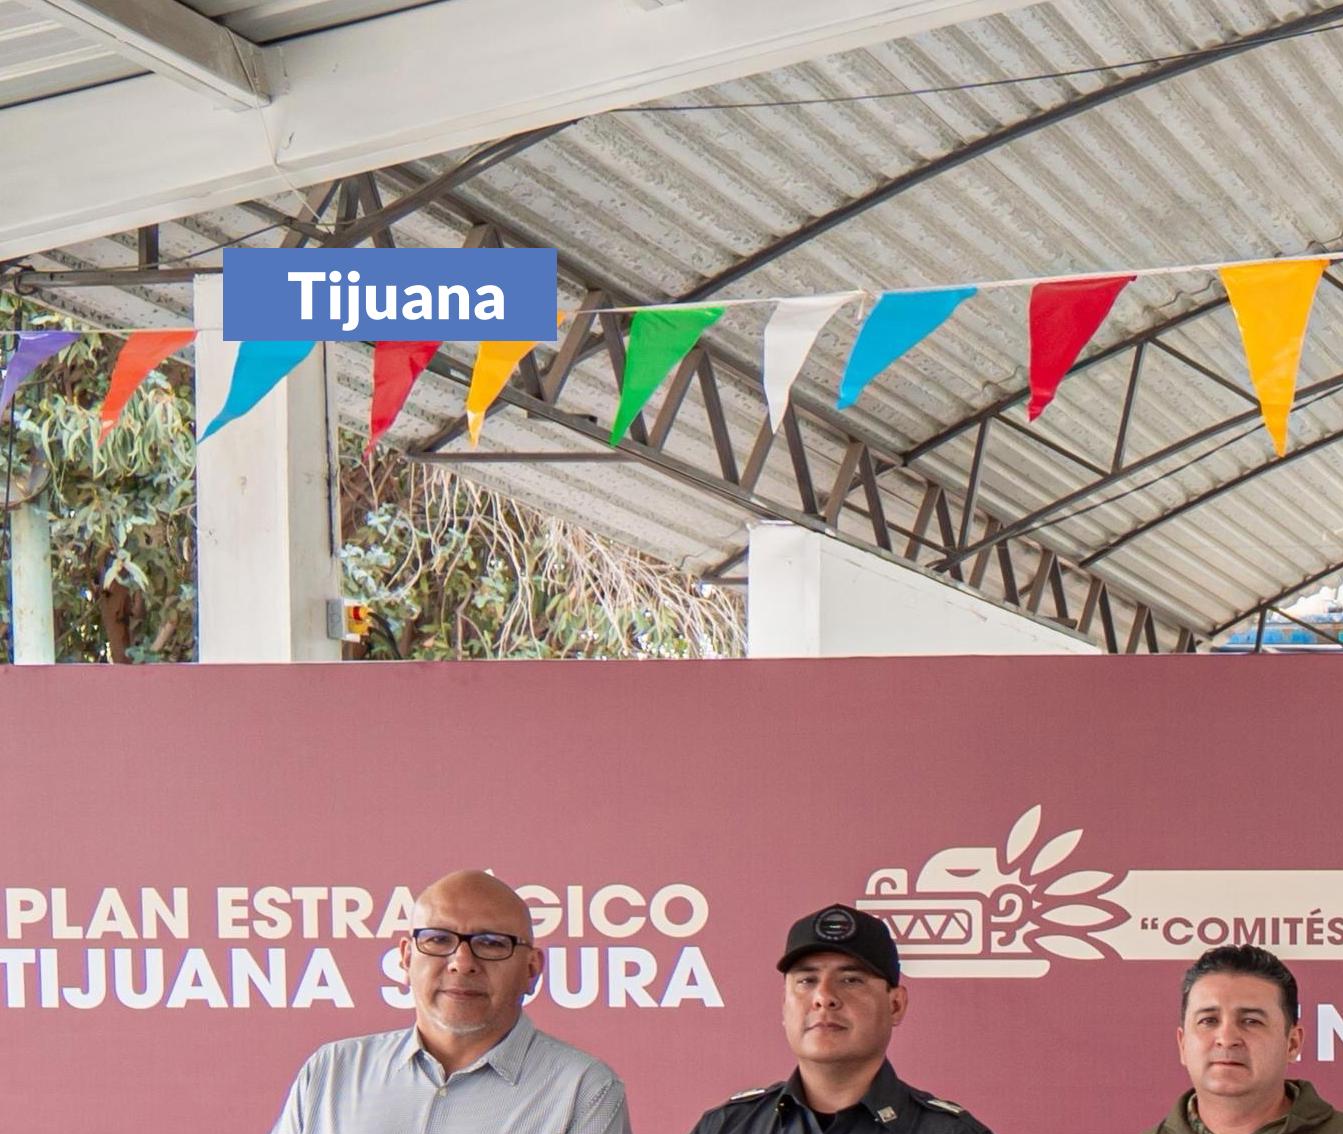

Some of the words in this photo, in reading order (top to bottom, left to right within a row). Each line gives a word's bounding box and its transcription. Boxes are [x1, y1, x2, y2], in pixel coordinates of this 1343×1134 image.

[5, 887, 190, 939] PLAN
[217, 869, 709, 938] ESTRAGICO
[0, 947, 355, 1009] TIJUANA
[381, 946, 725, 1009] SURA
